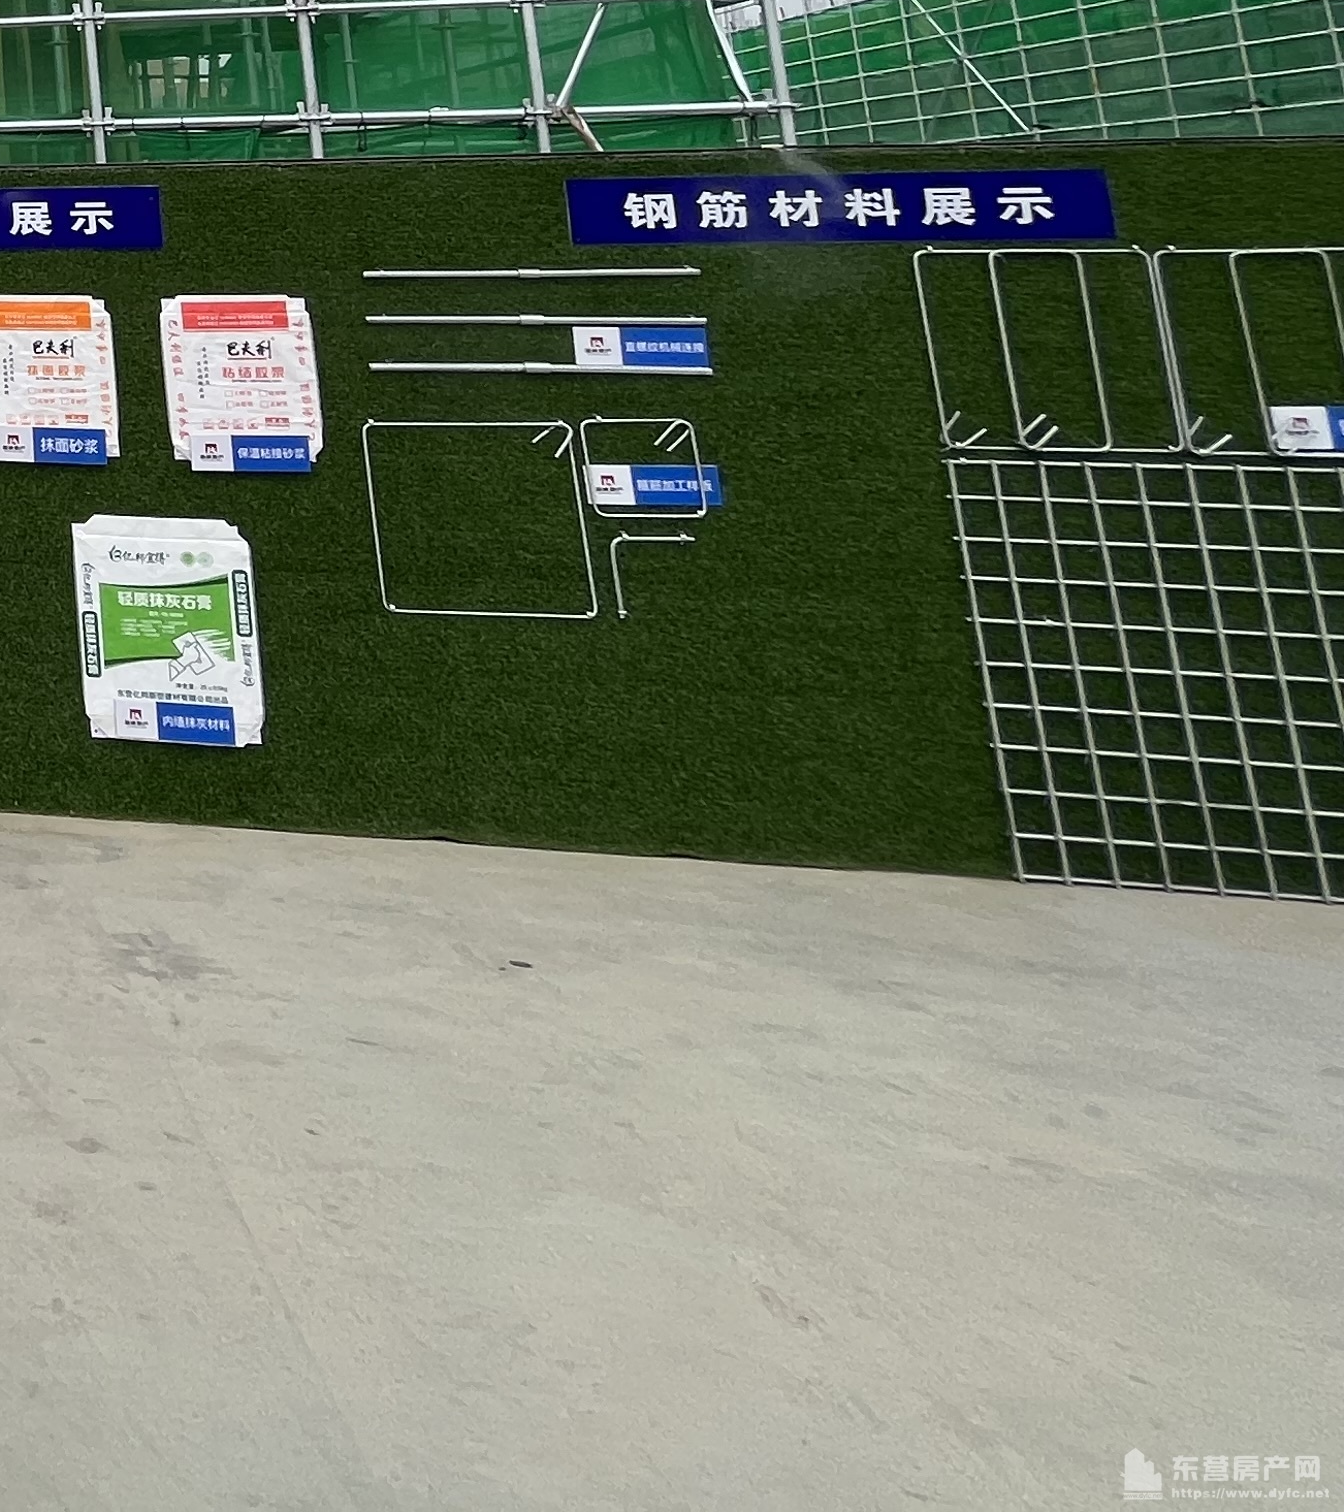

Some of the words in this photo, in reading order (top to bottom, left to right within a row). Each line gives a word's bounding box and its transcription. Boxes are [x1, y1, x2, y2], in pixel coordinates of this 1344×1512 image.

[622, 185, 1056, 231] 钢筋材料展示
[40, 437, 99, 454] 抹面砂浆
[117, 591, 213, 611] 轻质抹灰石膏
[161, 715, 230, 731] 内墙抹灰材料
